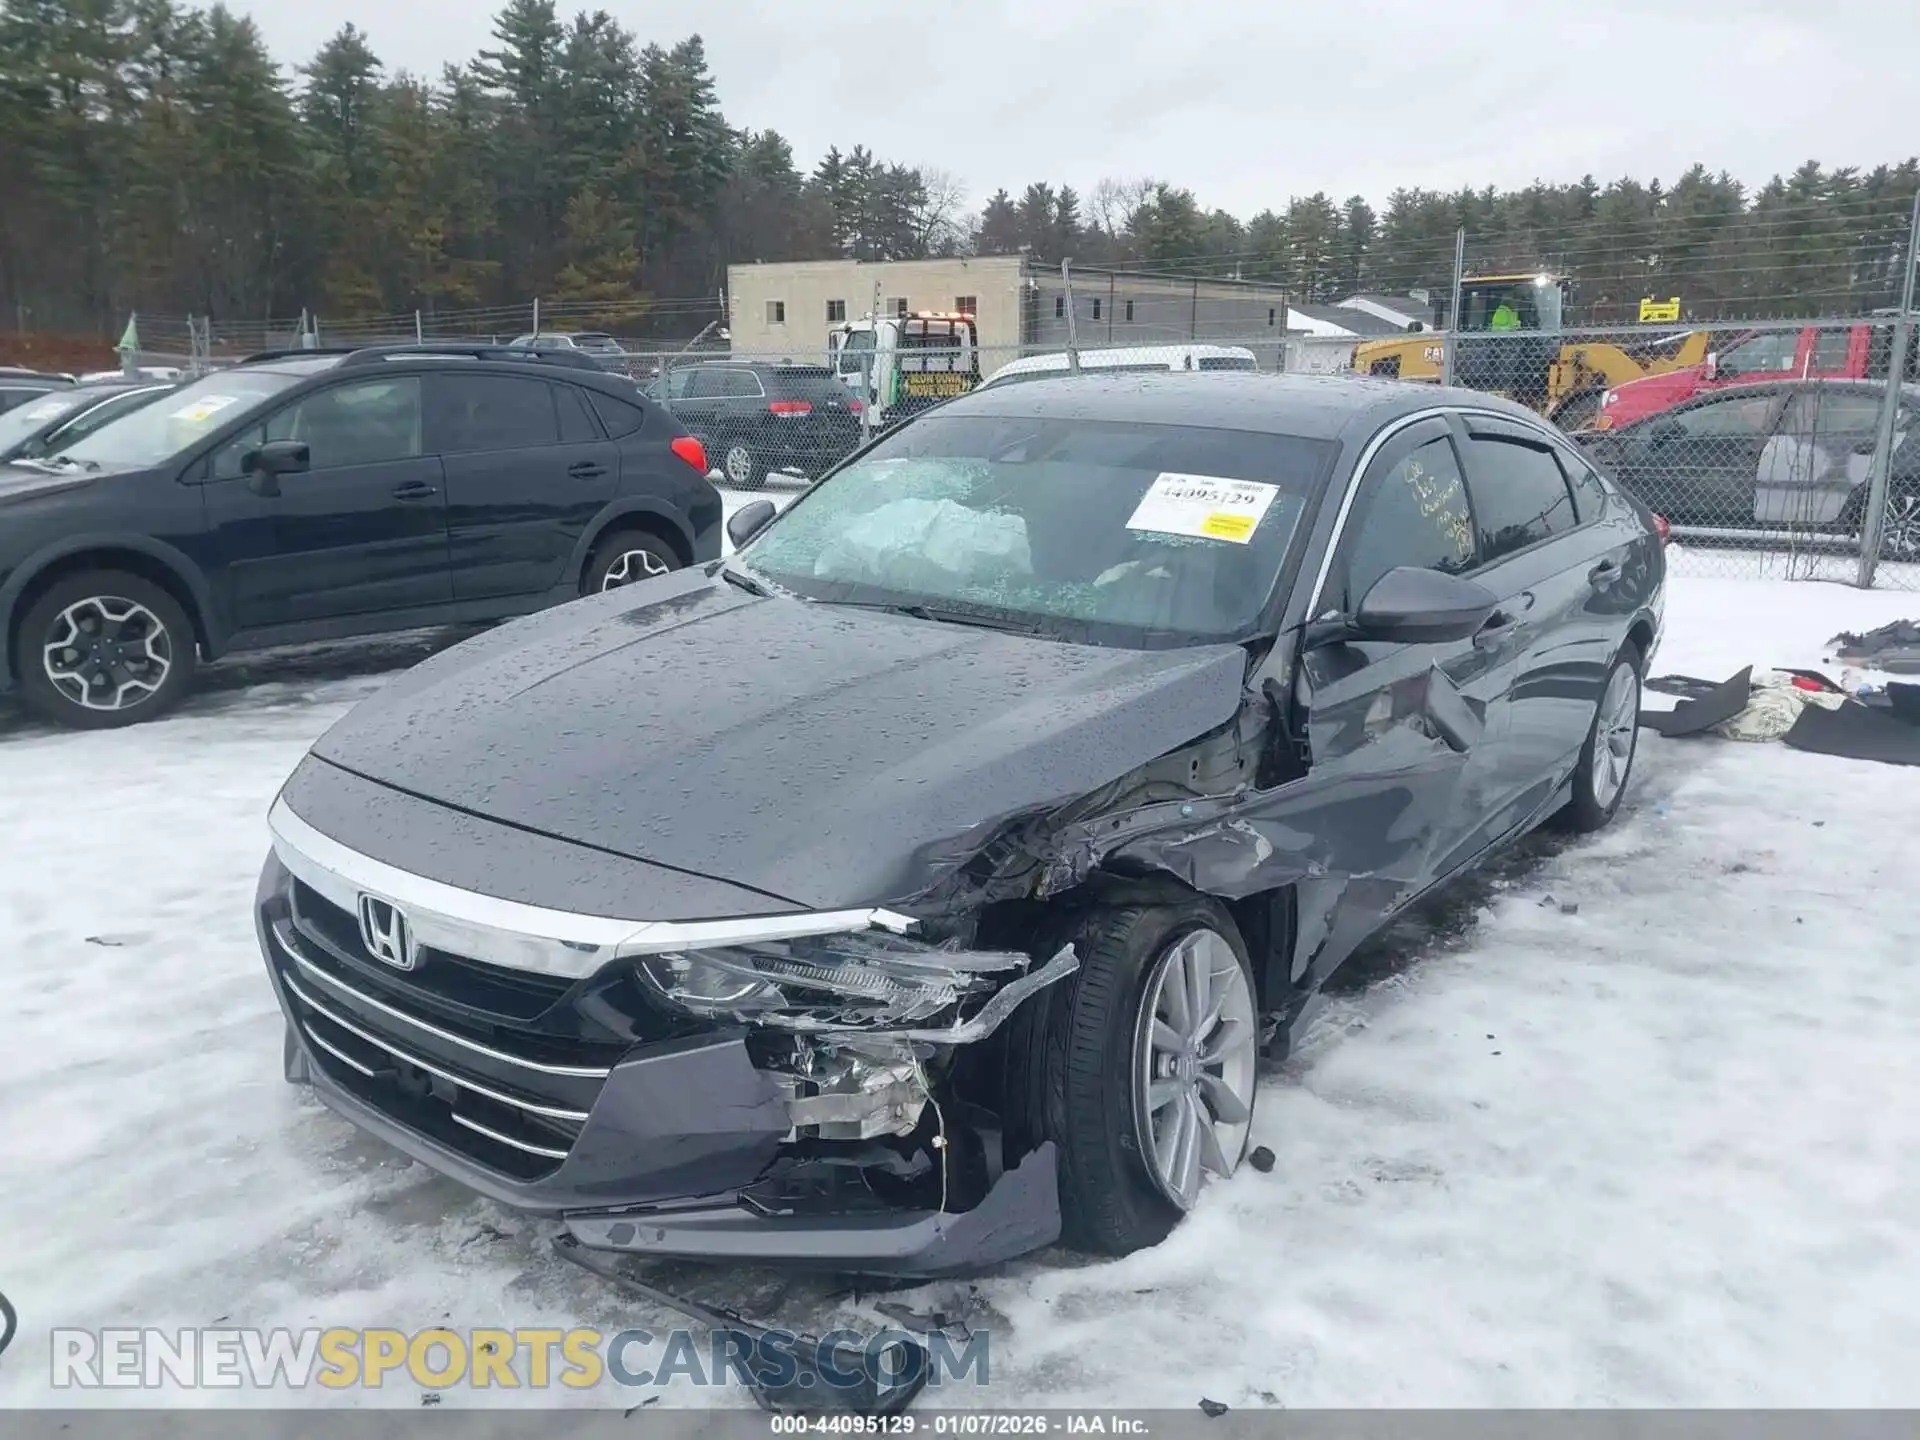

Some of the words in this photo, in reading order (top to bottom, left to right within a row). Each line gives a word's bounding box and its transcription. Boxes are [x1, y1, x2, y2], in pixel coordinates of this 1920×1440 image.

[908, 373, 933, 384] SLOW
[937, 373, 962, 384] DOWN
[908, 385, 935, 396] MOVE
[937, 385, 961, 396] OVER
